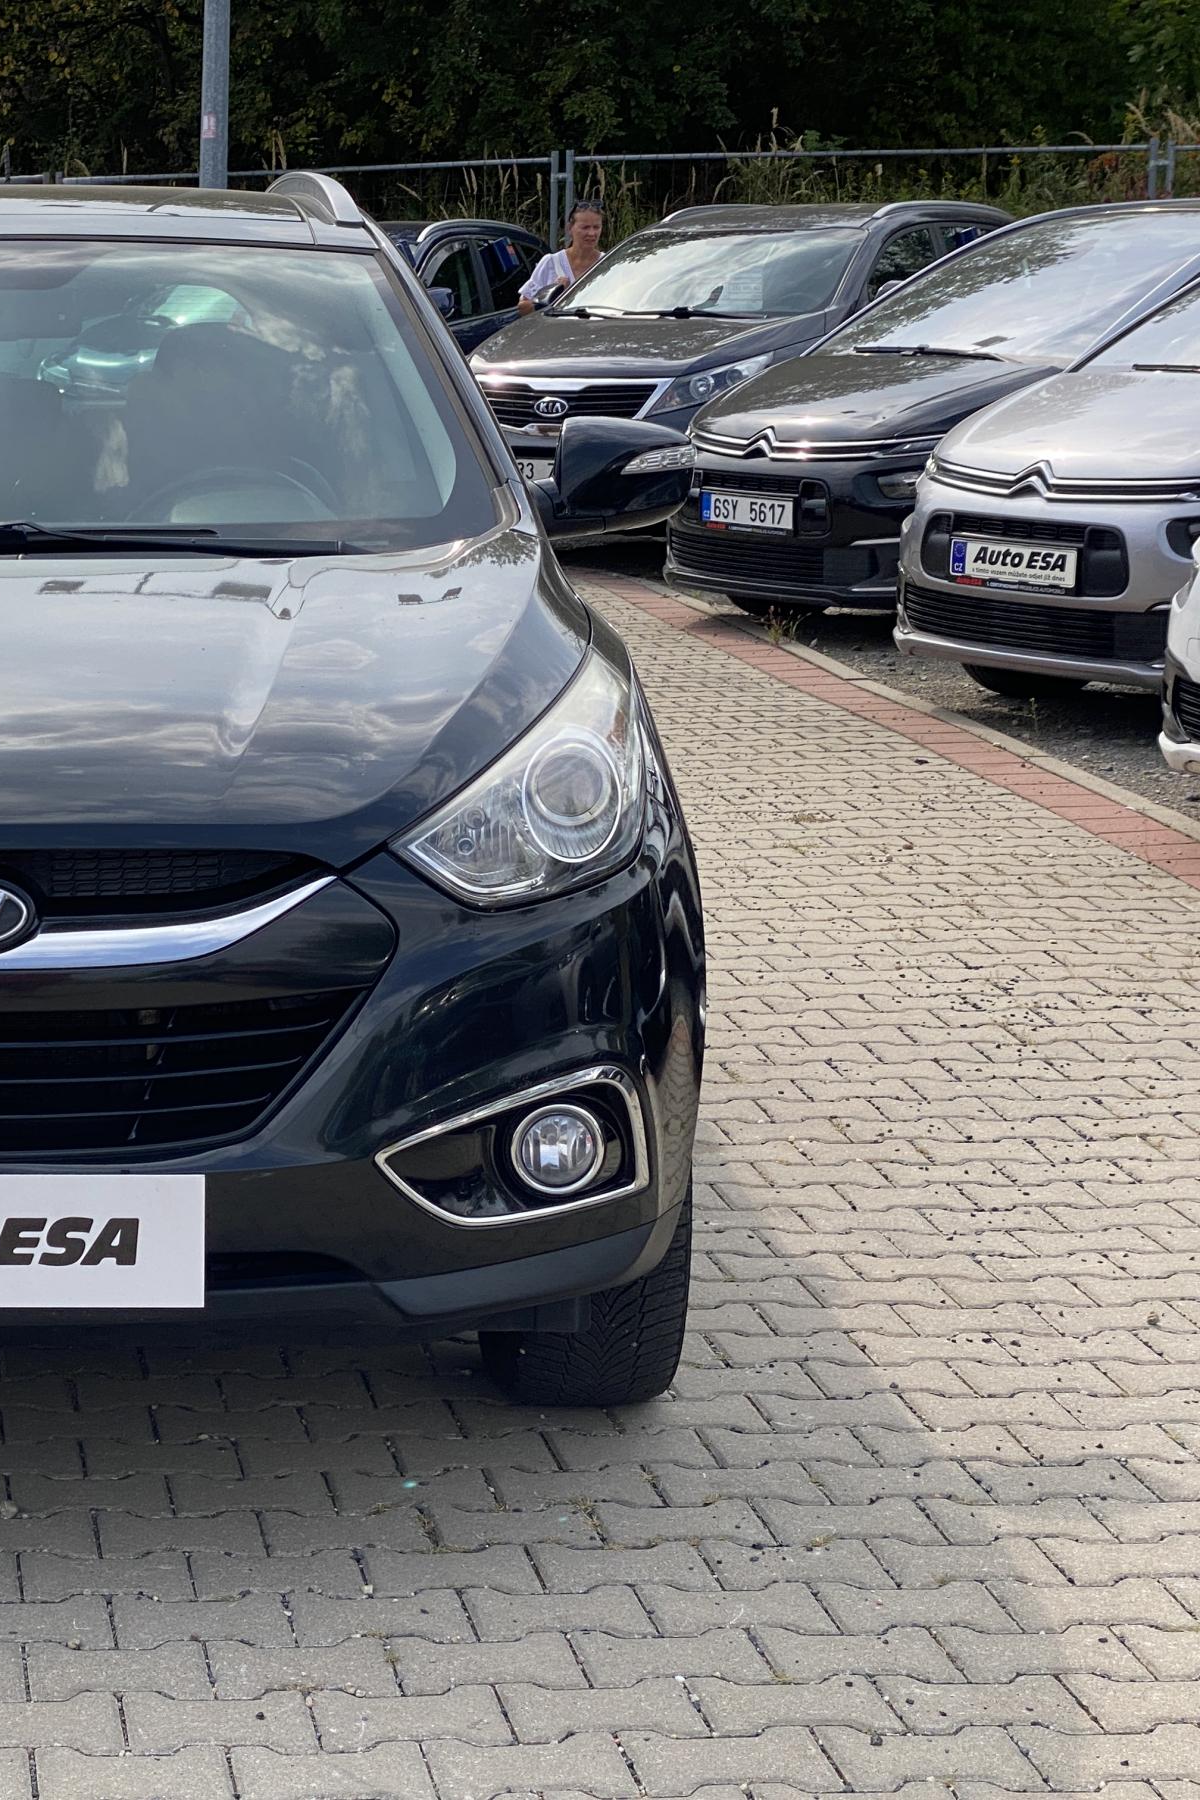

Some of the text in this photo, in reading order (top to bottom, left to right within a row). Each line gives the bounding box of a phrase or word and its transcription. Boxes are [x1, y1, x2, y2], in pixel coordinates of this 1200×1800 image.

[540, 402, 561, 413] KIA
[713, 498, 786, 525] 6SY 5617
[954, 562, 963, 572] CZ
[973, 546, 1068, 573] Auto ESA
